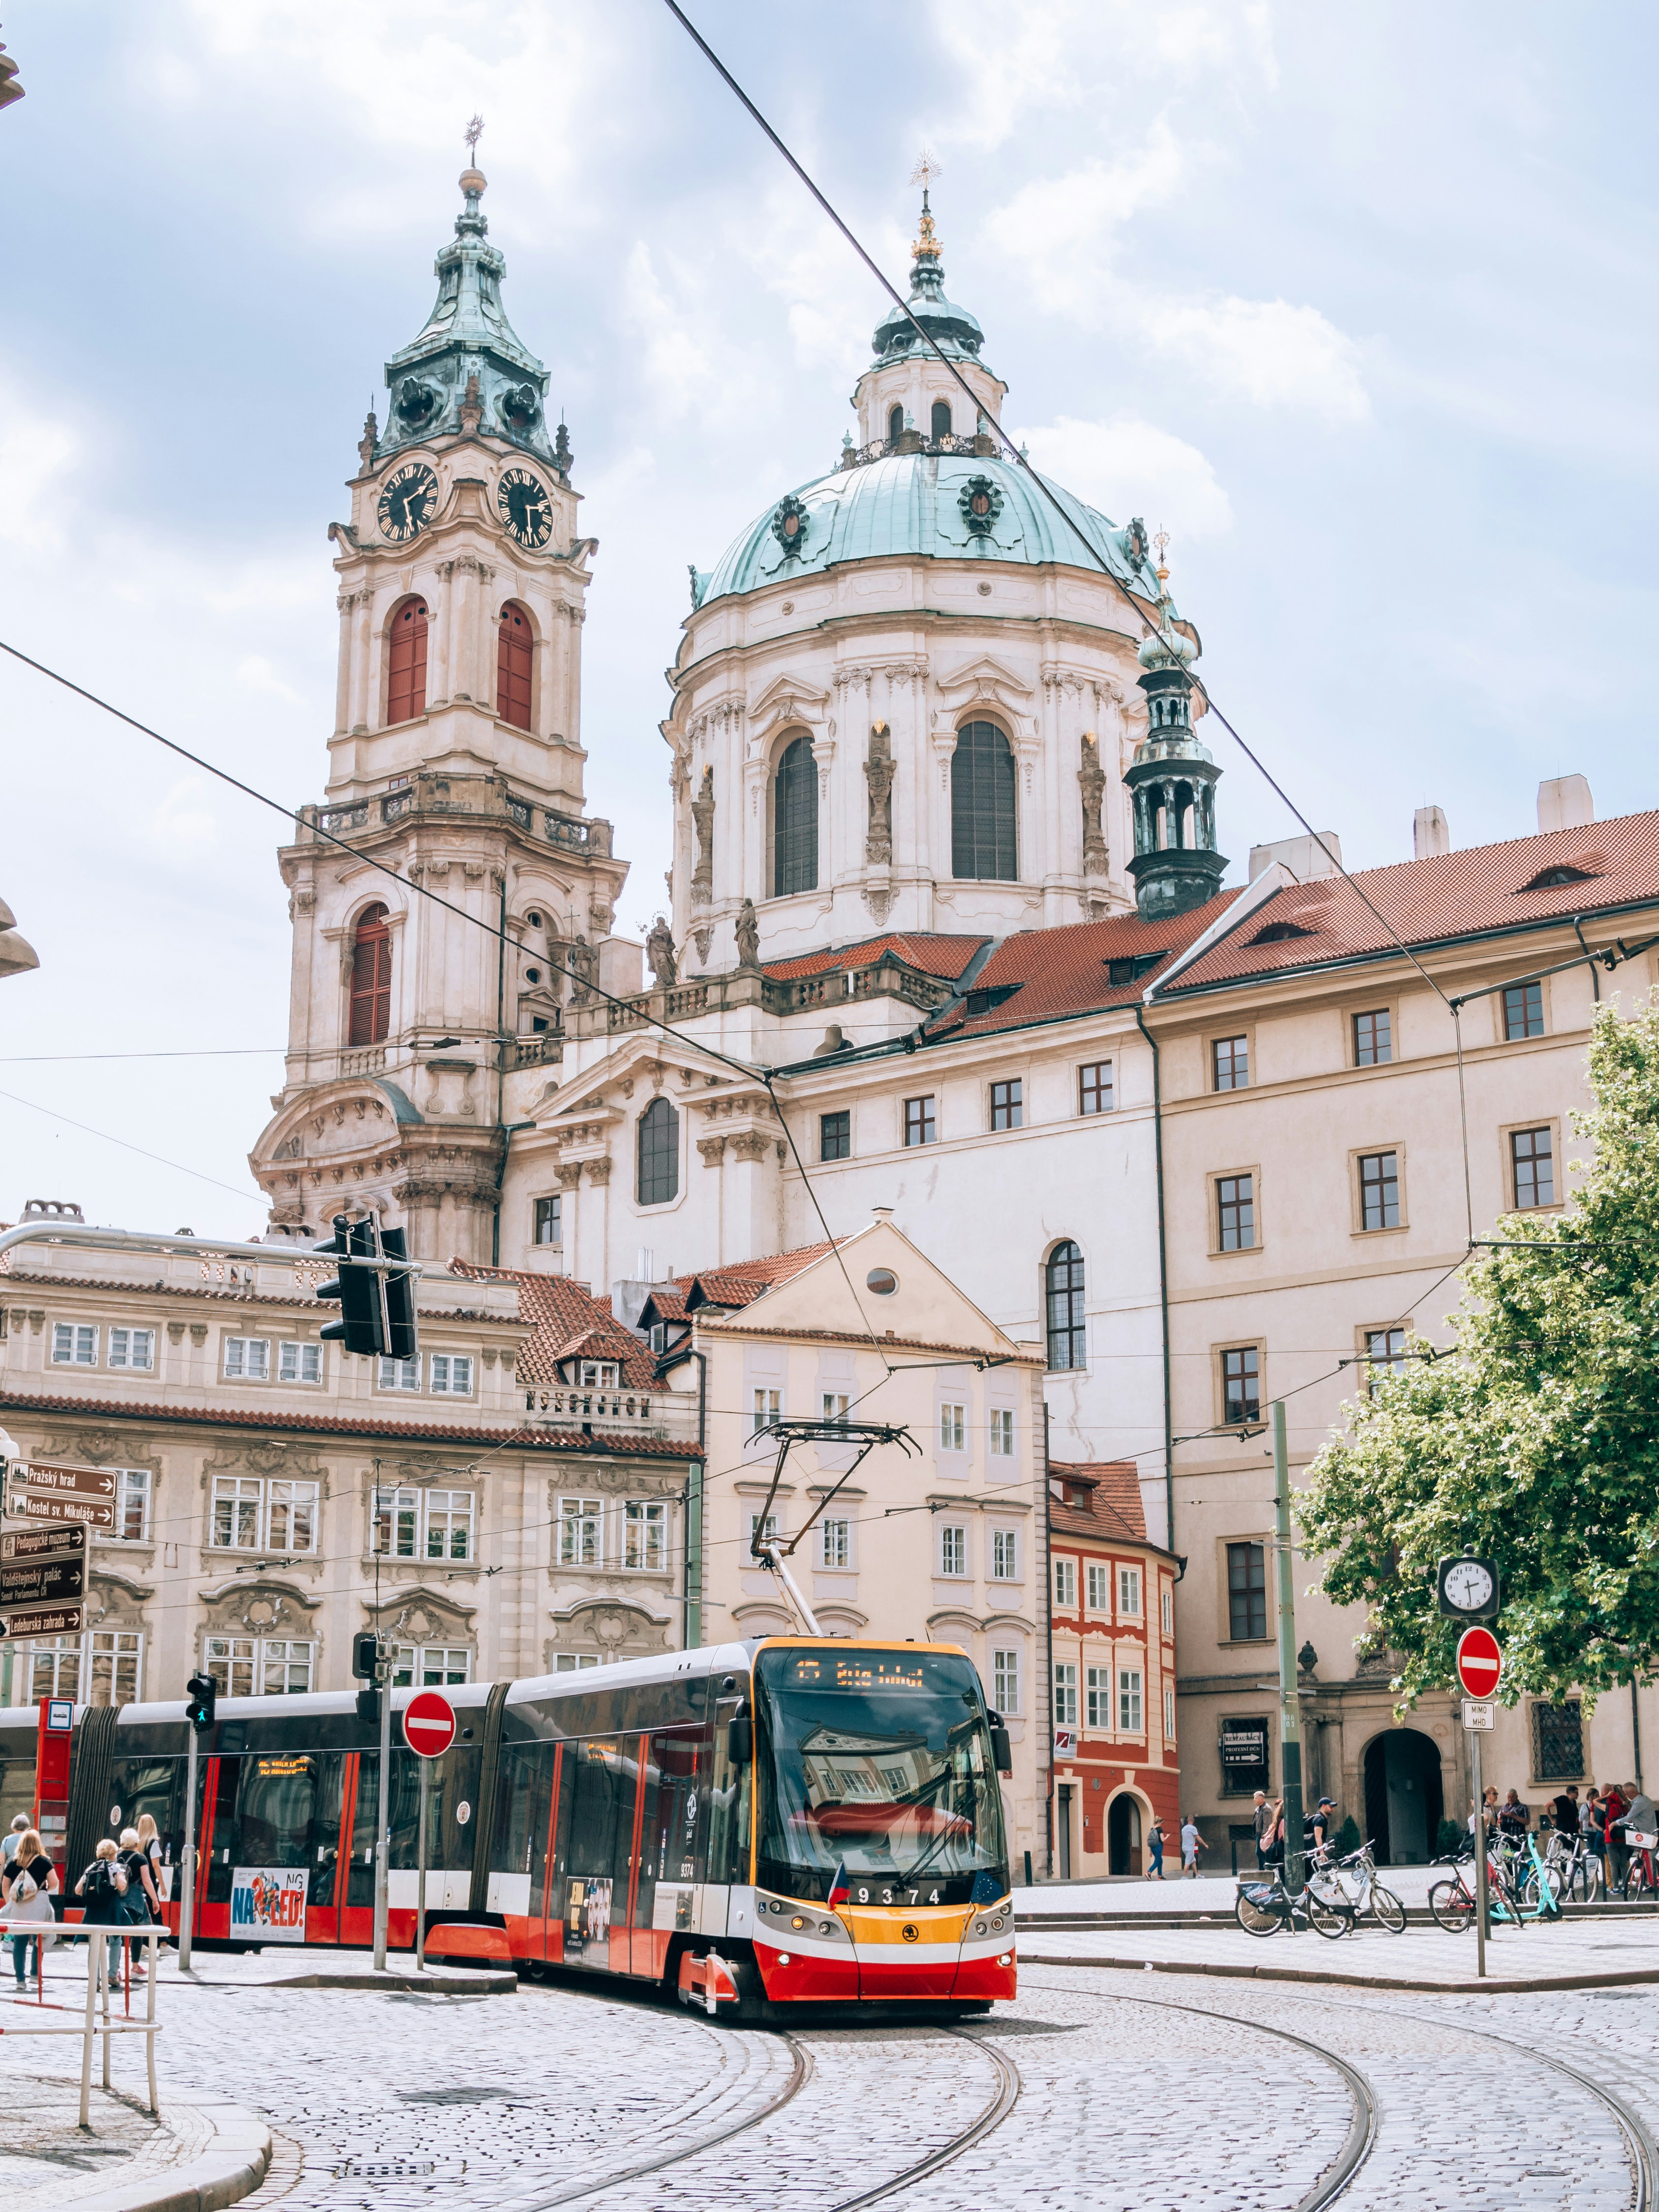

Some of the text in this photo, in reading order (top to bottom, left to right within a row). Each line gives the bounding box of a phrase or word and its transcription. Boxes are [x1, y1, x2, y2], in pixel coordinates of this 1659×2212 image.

[29, 1468, 75, 1488] Pražský hrad
[28, 1499, 94, 1521] Kostel sv. Mikuláše
[17, 1532, 70, 1552] Pedagogické muzeum
[2, 1567, 62, 1588] Valdštejnský palác
[1, 1585, 47, 1601] Senát Parlamentu ČR
[11, 1614, 64, 1633] Ledeburská zahrada
[1471, 1706, 1487, 1714] MIMO
[1472, 1718, 1486, 1726] MHD
[681, 1863, 693, 1878] 9374
[858, 1888, 939, 1904] 9374
[232, 1888, 305, 1928] NA LED!
